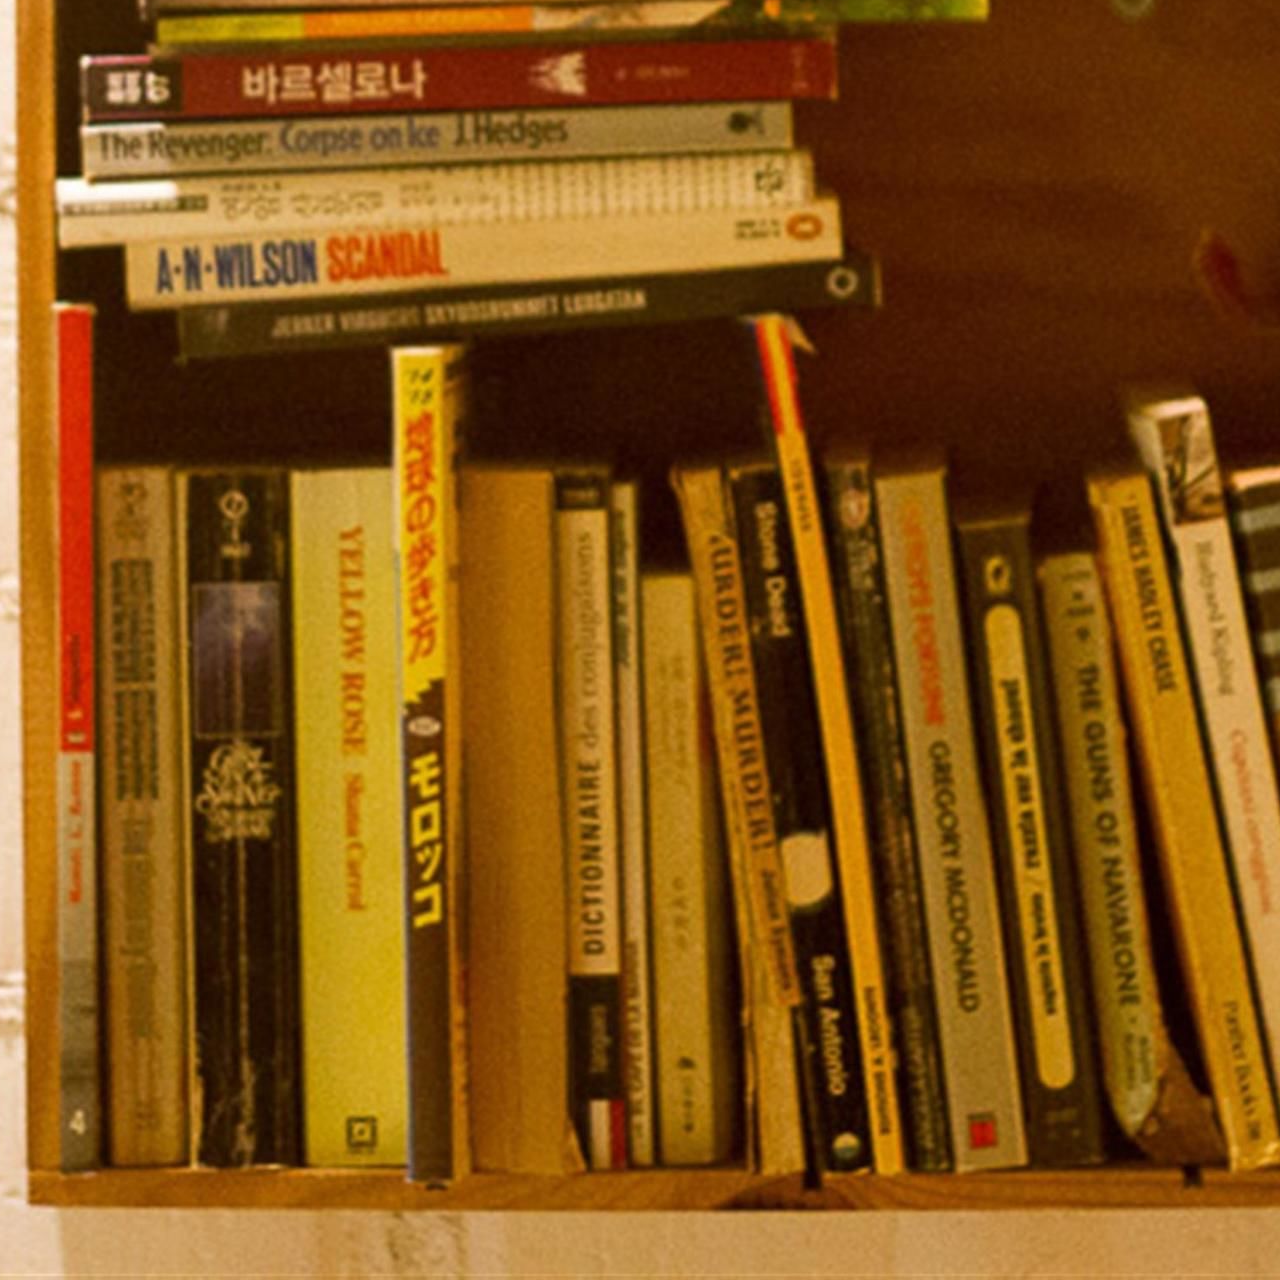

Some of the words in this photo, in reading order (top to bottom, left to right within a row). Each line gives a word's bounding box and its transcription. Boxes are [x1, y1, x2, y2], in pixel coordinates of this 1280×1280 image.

[243, 57, 427, 105] 바르셀로나
[99, 131, 143, 161] The
[279, 120, 363, 156] Corpse
[371, 125, 405, 150] on
[408, 118, 440, 149] Ice
[326, 231, 448, 283] SCANDAL
[755, 501, 784, 571] Stone
[338, 526, 368, 662] YELLOW
[573, 532, 600, 699] conjugaisons
[707, 535, 747, 679] URDER!
[767, 577, 793, 639] Dead
[1130, 567, 1164, 632] HADLEY
[1076, 663, 1103, 712] THE
[1143, 637, 1177, 695] CHASE
[339, 671, 368, 756] ROSE
[726, 688, 775, 851] MURDER!
[927, 741, 963, 858] GREGORY
[1081, 722, 1115, 803] GUNS
[407, 757, 445, 930] モロッコ
[582, 760, 607, 957] DICTIONNAIRE
[1097, 812, 1122, 847] OF
[1099, 856, 1142, 1006] NAVARONE
[810, 954, 837, 1001] San
[820, 1007, 851, 1096] Antonio
